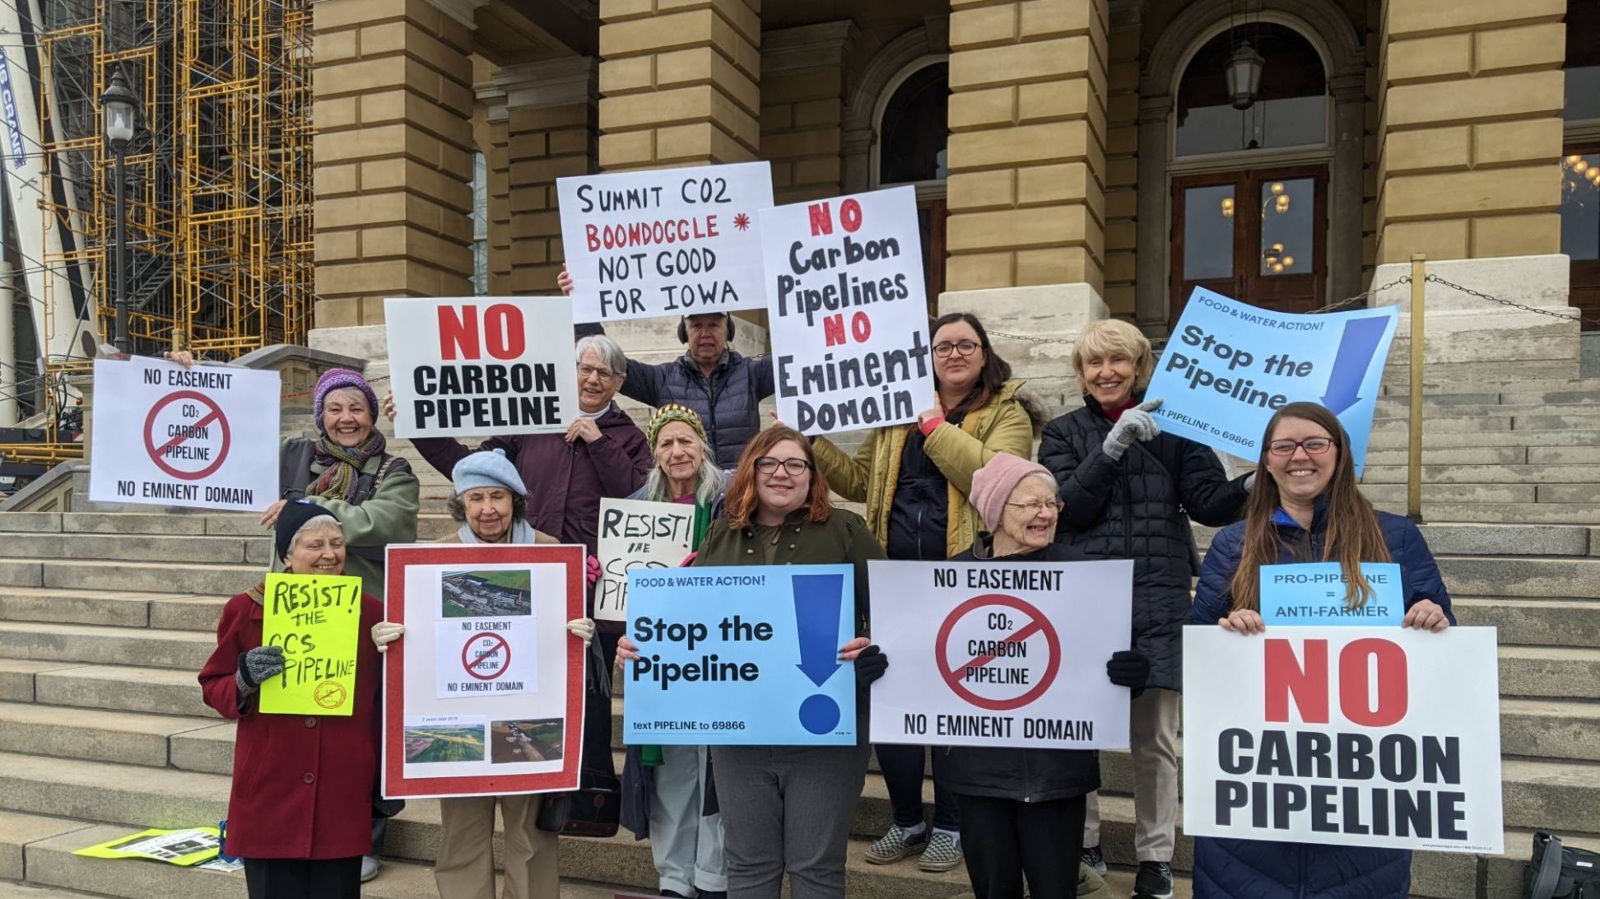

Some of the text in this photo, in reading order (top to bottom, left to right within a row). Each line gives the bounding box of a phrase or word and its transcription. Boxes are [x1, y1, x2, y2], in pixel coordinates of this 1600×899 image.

[576, 177, 731, 213] SUMMIT CO2
[586, 215, 719, 252] BOONDOGGLE
[808, 198, 863, 236] NO
[598, 247, 716, 284] NOT GOOD
[789, 235, 900, 275] Carbon
[599, 280, 739, 318] FOR IOWA
[777, 272, 909, 327] Pipelines
[1198, 296, 1325, 331] FOOD & WATER ACTION!
[437, 303, 525, 361] NO
[823, 311, 872, 347] NO
[778, 330, 929, 398] Eminent
[1181, 325, 1313, 377] Stop the
[144, 368, 233, 389] NO EASEMENT
[413, 363, 557, 396] CARBON
[1165, 352, 1288, 410] Pipeline
[414, 396, 562, 429] PIPELINE
[1167, 410, 1210, 431] PIPELINE
[1210, 426, 1221, 436] to
[1222, 431, 1255, 448] 69866
[167, 424, 208, 440] CARBON
[165, 445, 210, 461] PIPELINE
[117, 480, 253, 505] NO EMINENT DOMAIN
[602, 508, 692, 548] RESIST!
[635, 575, 766, 588] FOOD & WATER ACTION!
[933, 568, 1064, 591] NO EASEMENT
[1274, 573, 1388, 584] PRO-PIPENE
[462, 621, 512, 631] NO EASEMENT
[1275, 606, 1389, 617] ANTI-FARMER
[633, 615, 773, 651] Stop the
[967, 640, 1027, 658] CARBON
[281, 657, 355, 689] PIPELINE
[447, 681, 524, 692] NO EMINENT DOMAIN
[632, 654, 759, 690] Pipeline
[965, 666, 1029, 685] PIPELINE
[1264, 637, 1408, 728] NO
[633, 721, 746, 730] text PIPELINE to 69866
[904, 713, 1093, 741] NO EMINENT DOMAIN
[1218, 727, 1461, 785] CARBON
[1215, 779, 1468, 841] PIPELINE
